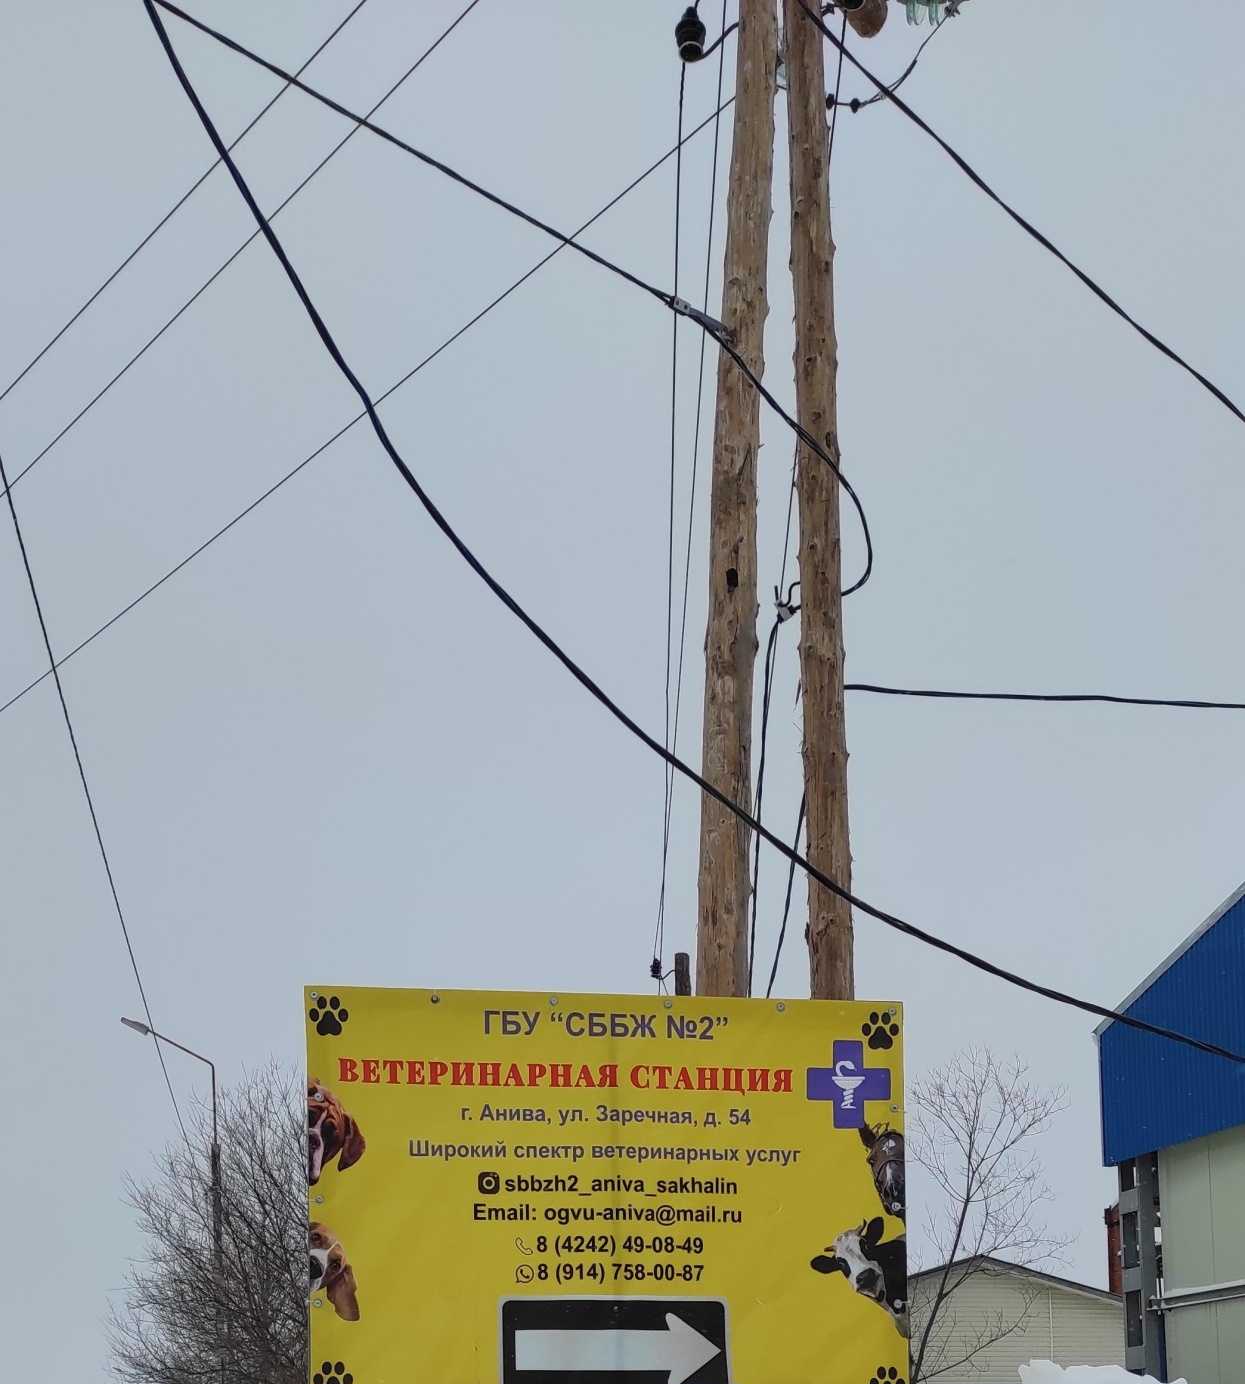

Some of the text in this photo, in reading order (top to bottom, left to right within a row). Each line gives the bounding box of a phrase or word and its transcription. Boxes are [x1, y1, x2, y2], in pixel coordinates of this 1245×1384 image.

[485, 1010, 540, 1035] ГБУ
[338, 1058, 792, 1094] ВЕТЕРИНАРНАЯ СТАНЦИЯ
[461, 1104, 752, 1129] г. Анива, ул. Заречная, д. 54
[410, 1140, 800, 1166] Широкий спектр ветеринарных услуг
[505, 1175, 737, 1197] sbbzh2_aniva_sakhalin
[474, 1203, 741, 1226] Email: ogvu-aniva@mail.ru
[536, 1235, 703, 1257] 8 (4242) 49-08-49
[537, 1263, 704, 1285] 8 (914) 758-00-87
